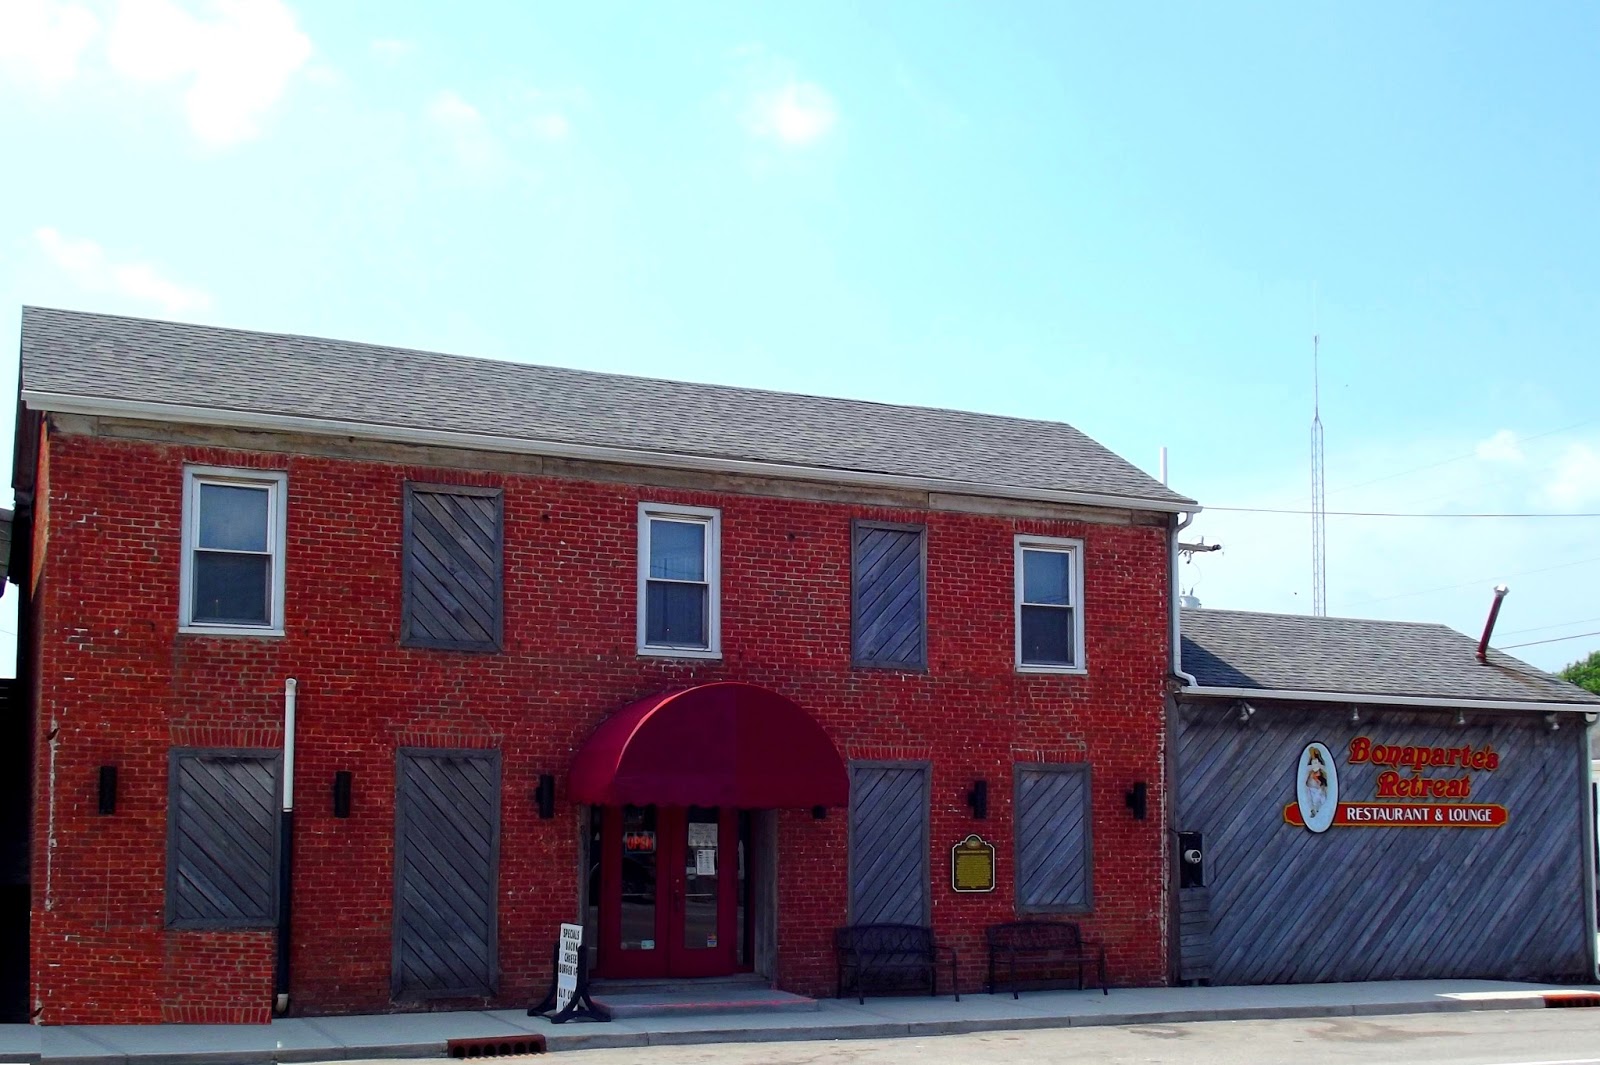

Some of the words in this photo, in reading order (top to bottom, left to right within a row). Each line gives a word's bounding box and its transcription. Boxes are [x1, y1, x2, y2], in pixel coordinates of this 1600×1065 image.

[1349, 736, 1500, 771] Bonaparte's
[1376, 771, 1471, 798] Retreat
[1347, 807, 1430, 821] RESTAURANT
[1435, 809, 1443, 822] &
[1449, 808, 1492, 822] LOUNGE
[627, 835, 653, 850] OPEN
[563, 928, 580, 940] SPECIALS
